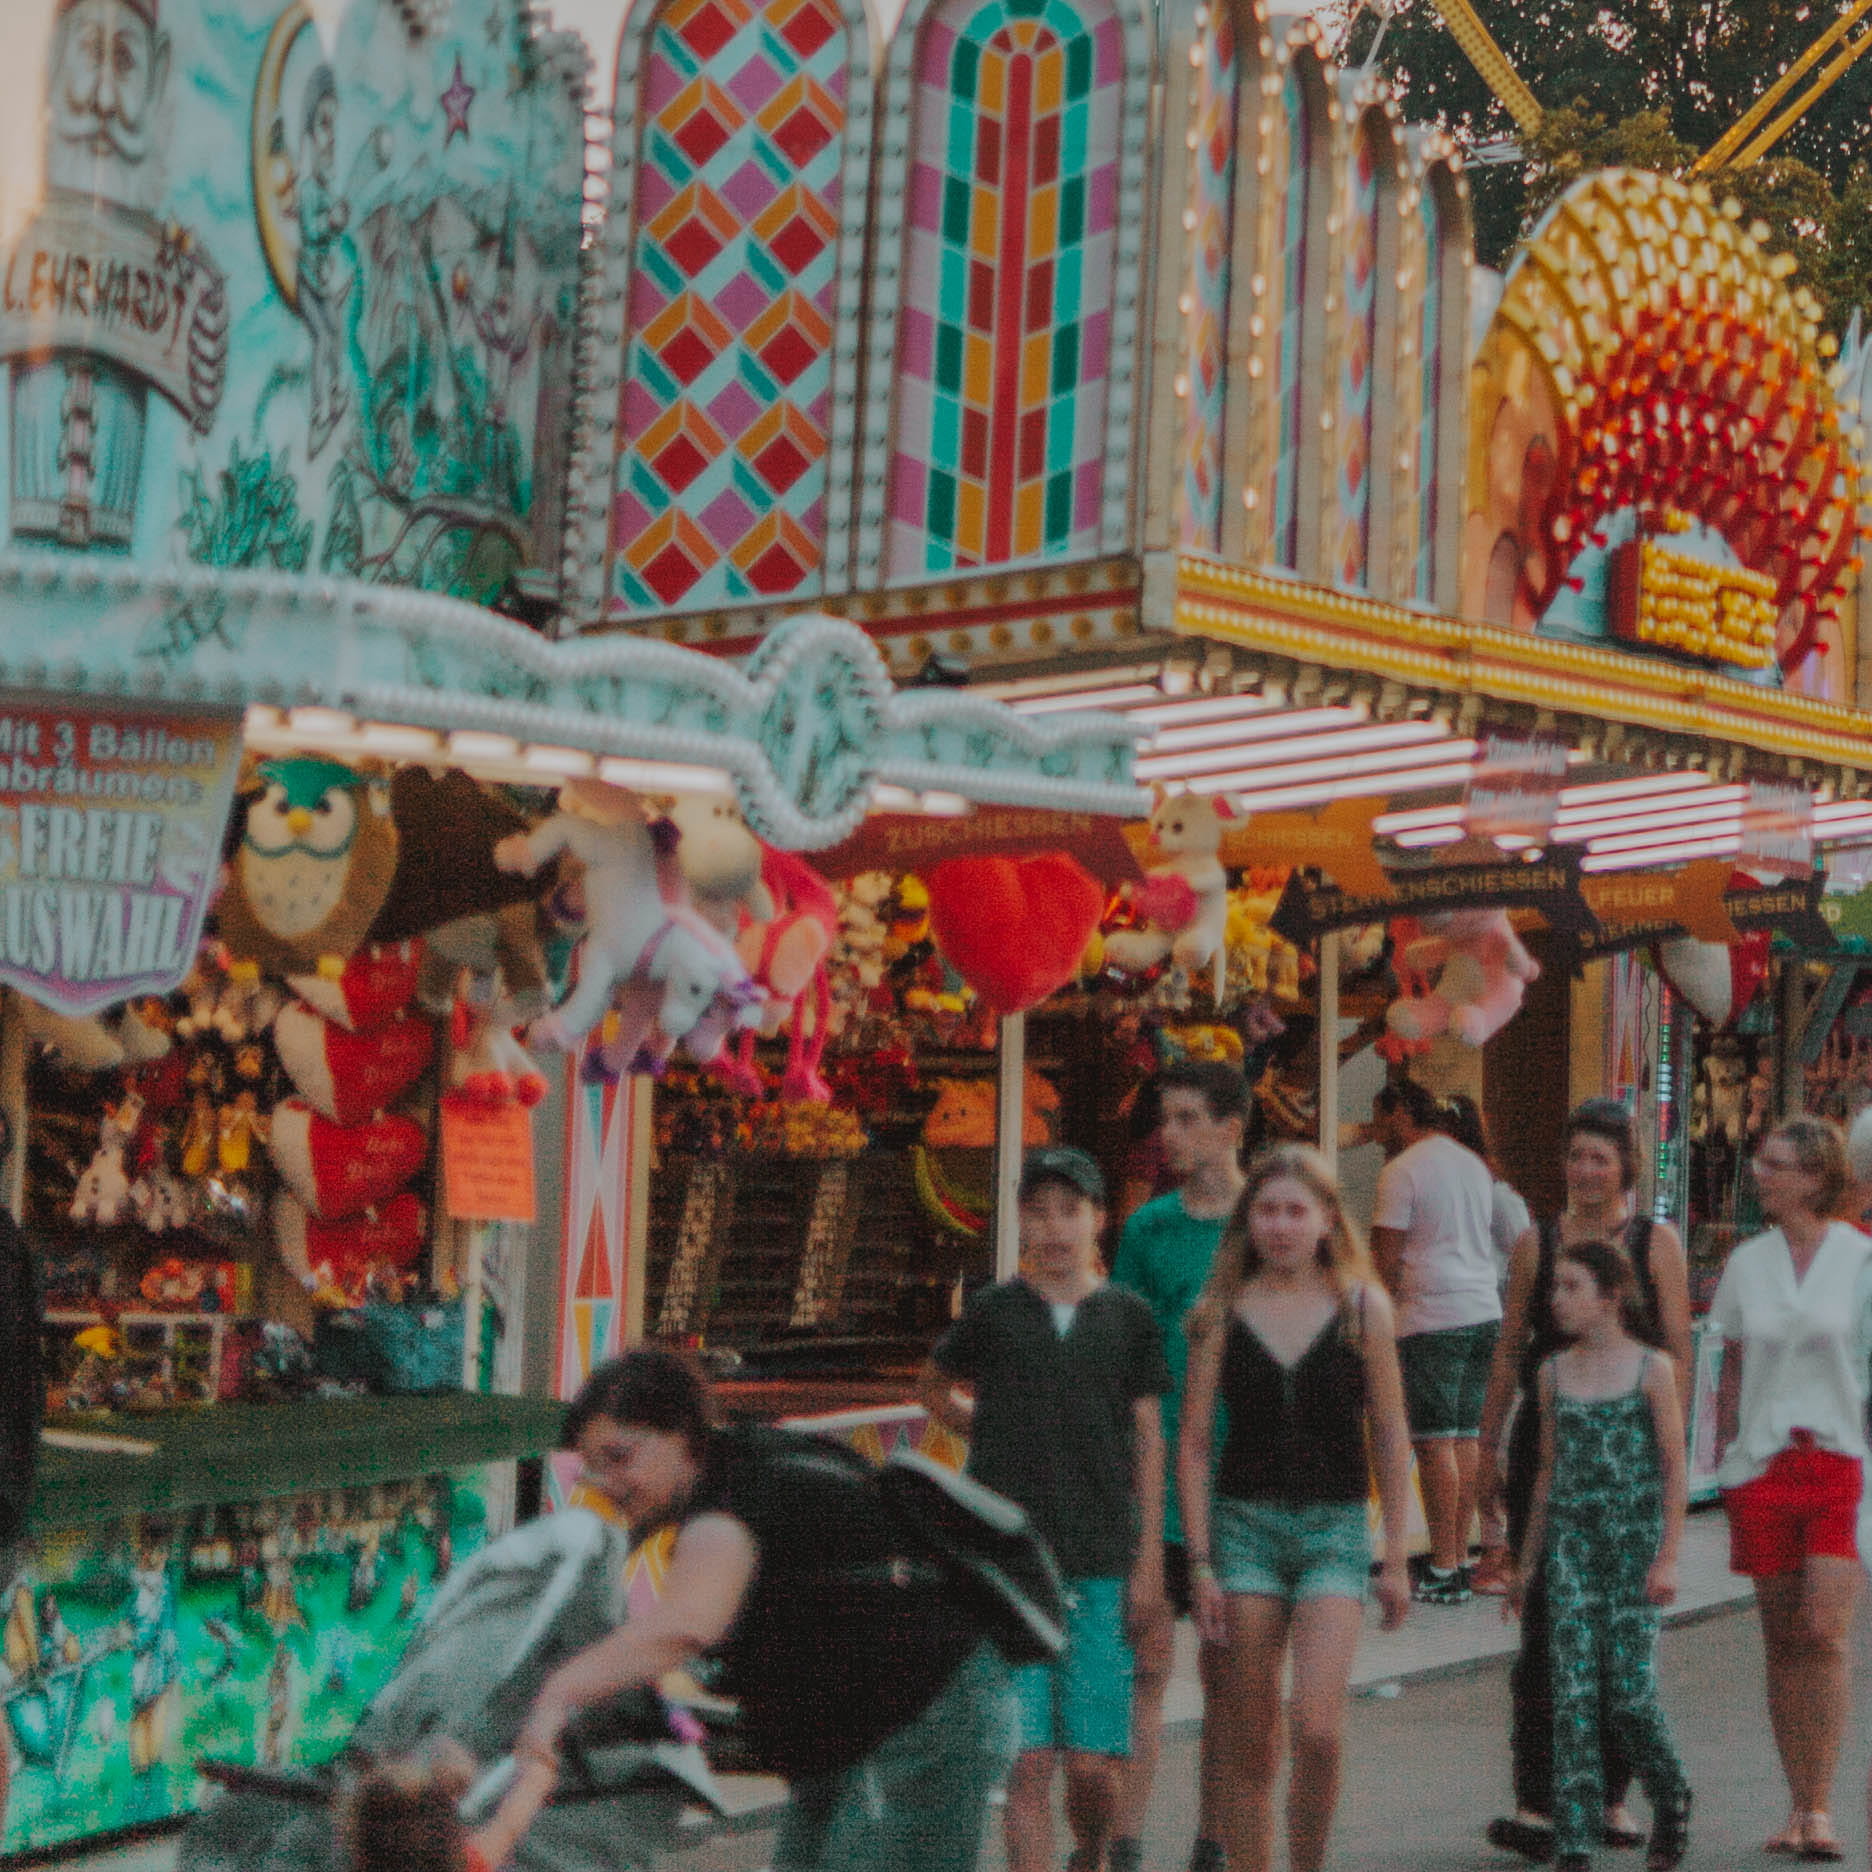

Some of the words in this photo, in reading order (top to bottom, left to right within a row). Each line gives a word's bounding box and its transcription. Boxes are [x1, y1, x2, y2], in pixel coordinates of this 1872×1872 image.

[53, 721, 75, 758] 3
[19, 804, 163, 885] FREIE
[0, 884, 187, 982] USWAHL
